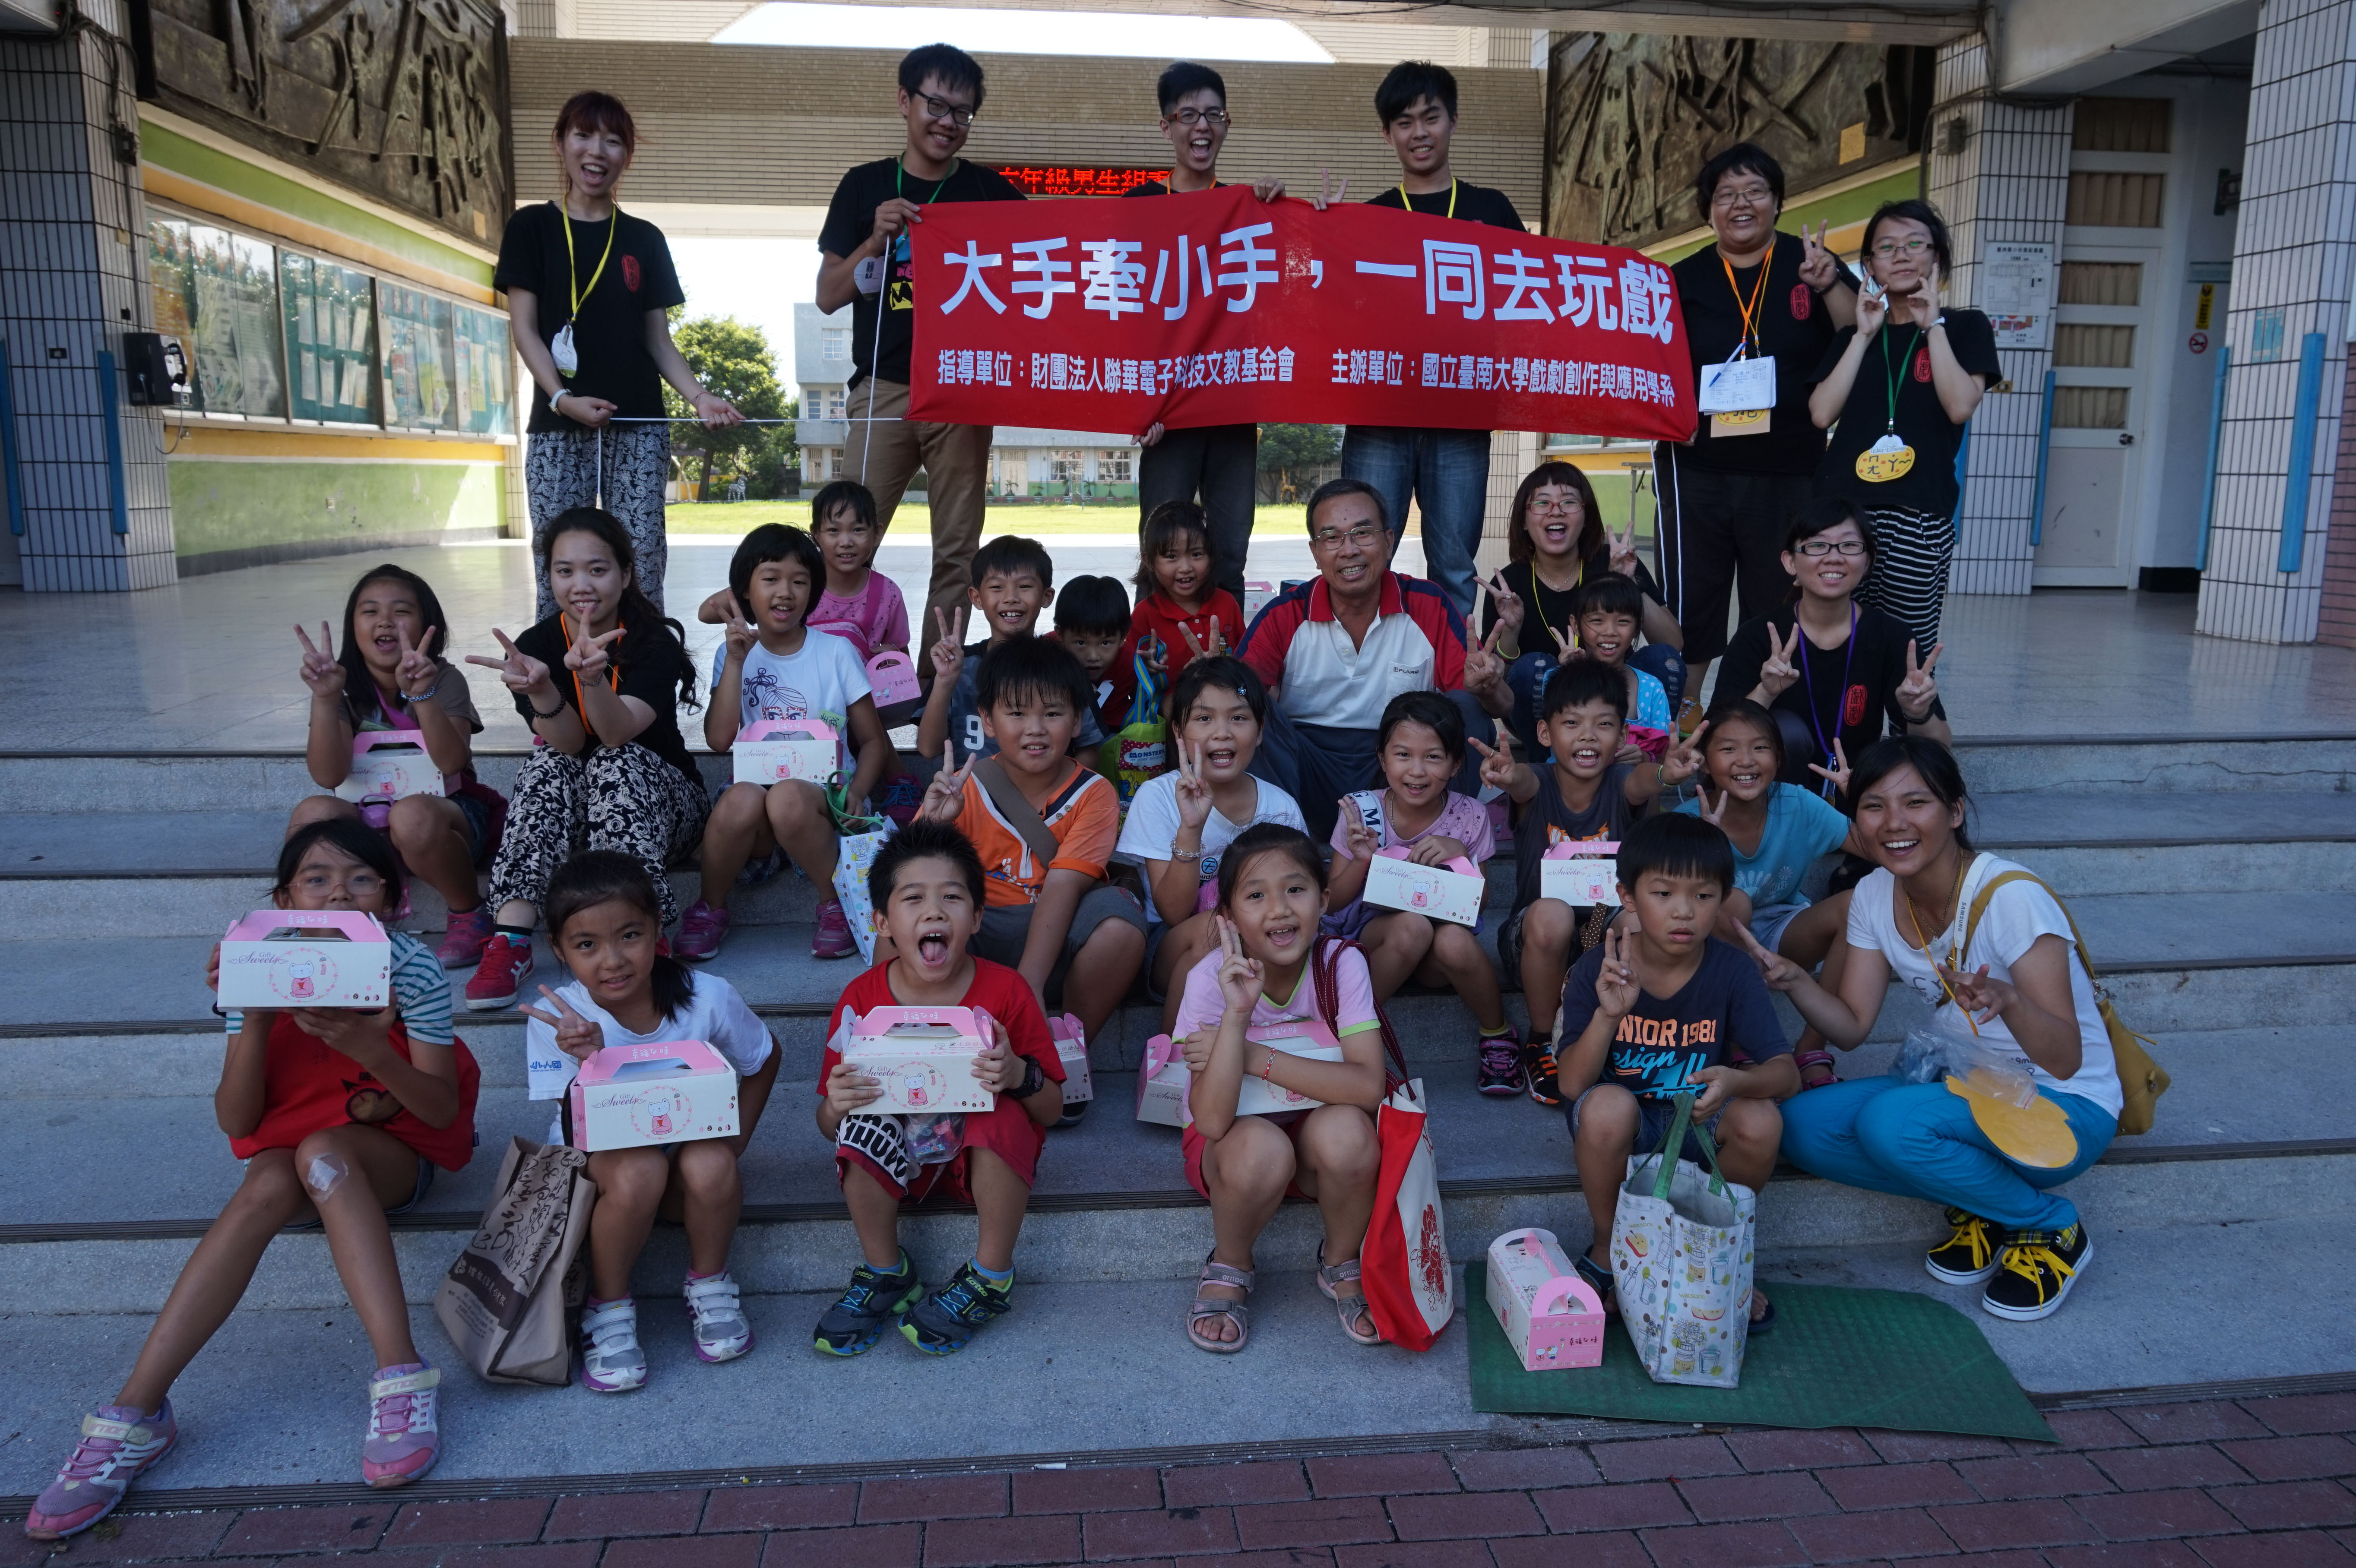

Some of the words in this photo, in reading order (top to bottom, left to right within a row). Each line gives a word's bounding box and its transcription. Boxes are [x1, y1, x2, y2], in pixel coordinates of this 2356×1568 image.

[939, 220, 1674, 345] 大手牽小手，一同去玩戲
[937, 345, 1295, 396] 指導單位：財團法人聯華電子科技文教基金會
[1331, 348, 1675, 408] 主辦單位：國立臺南大學戲劇創作與應用學系
[964, 715, 984, 750] 9
[1957, 901, 1967, 933] SAMSUNG
[1681, 1019, 1716, 1046] 1981
[1222, 1275, 1244, 1283] arriba
[1339, 1268, 1360, 1277] arriba
